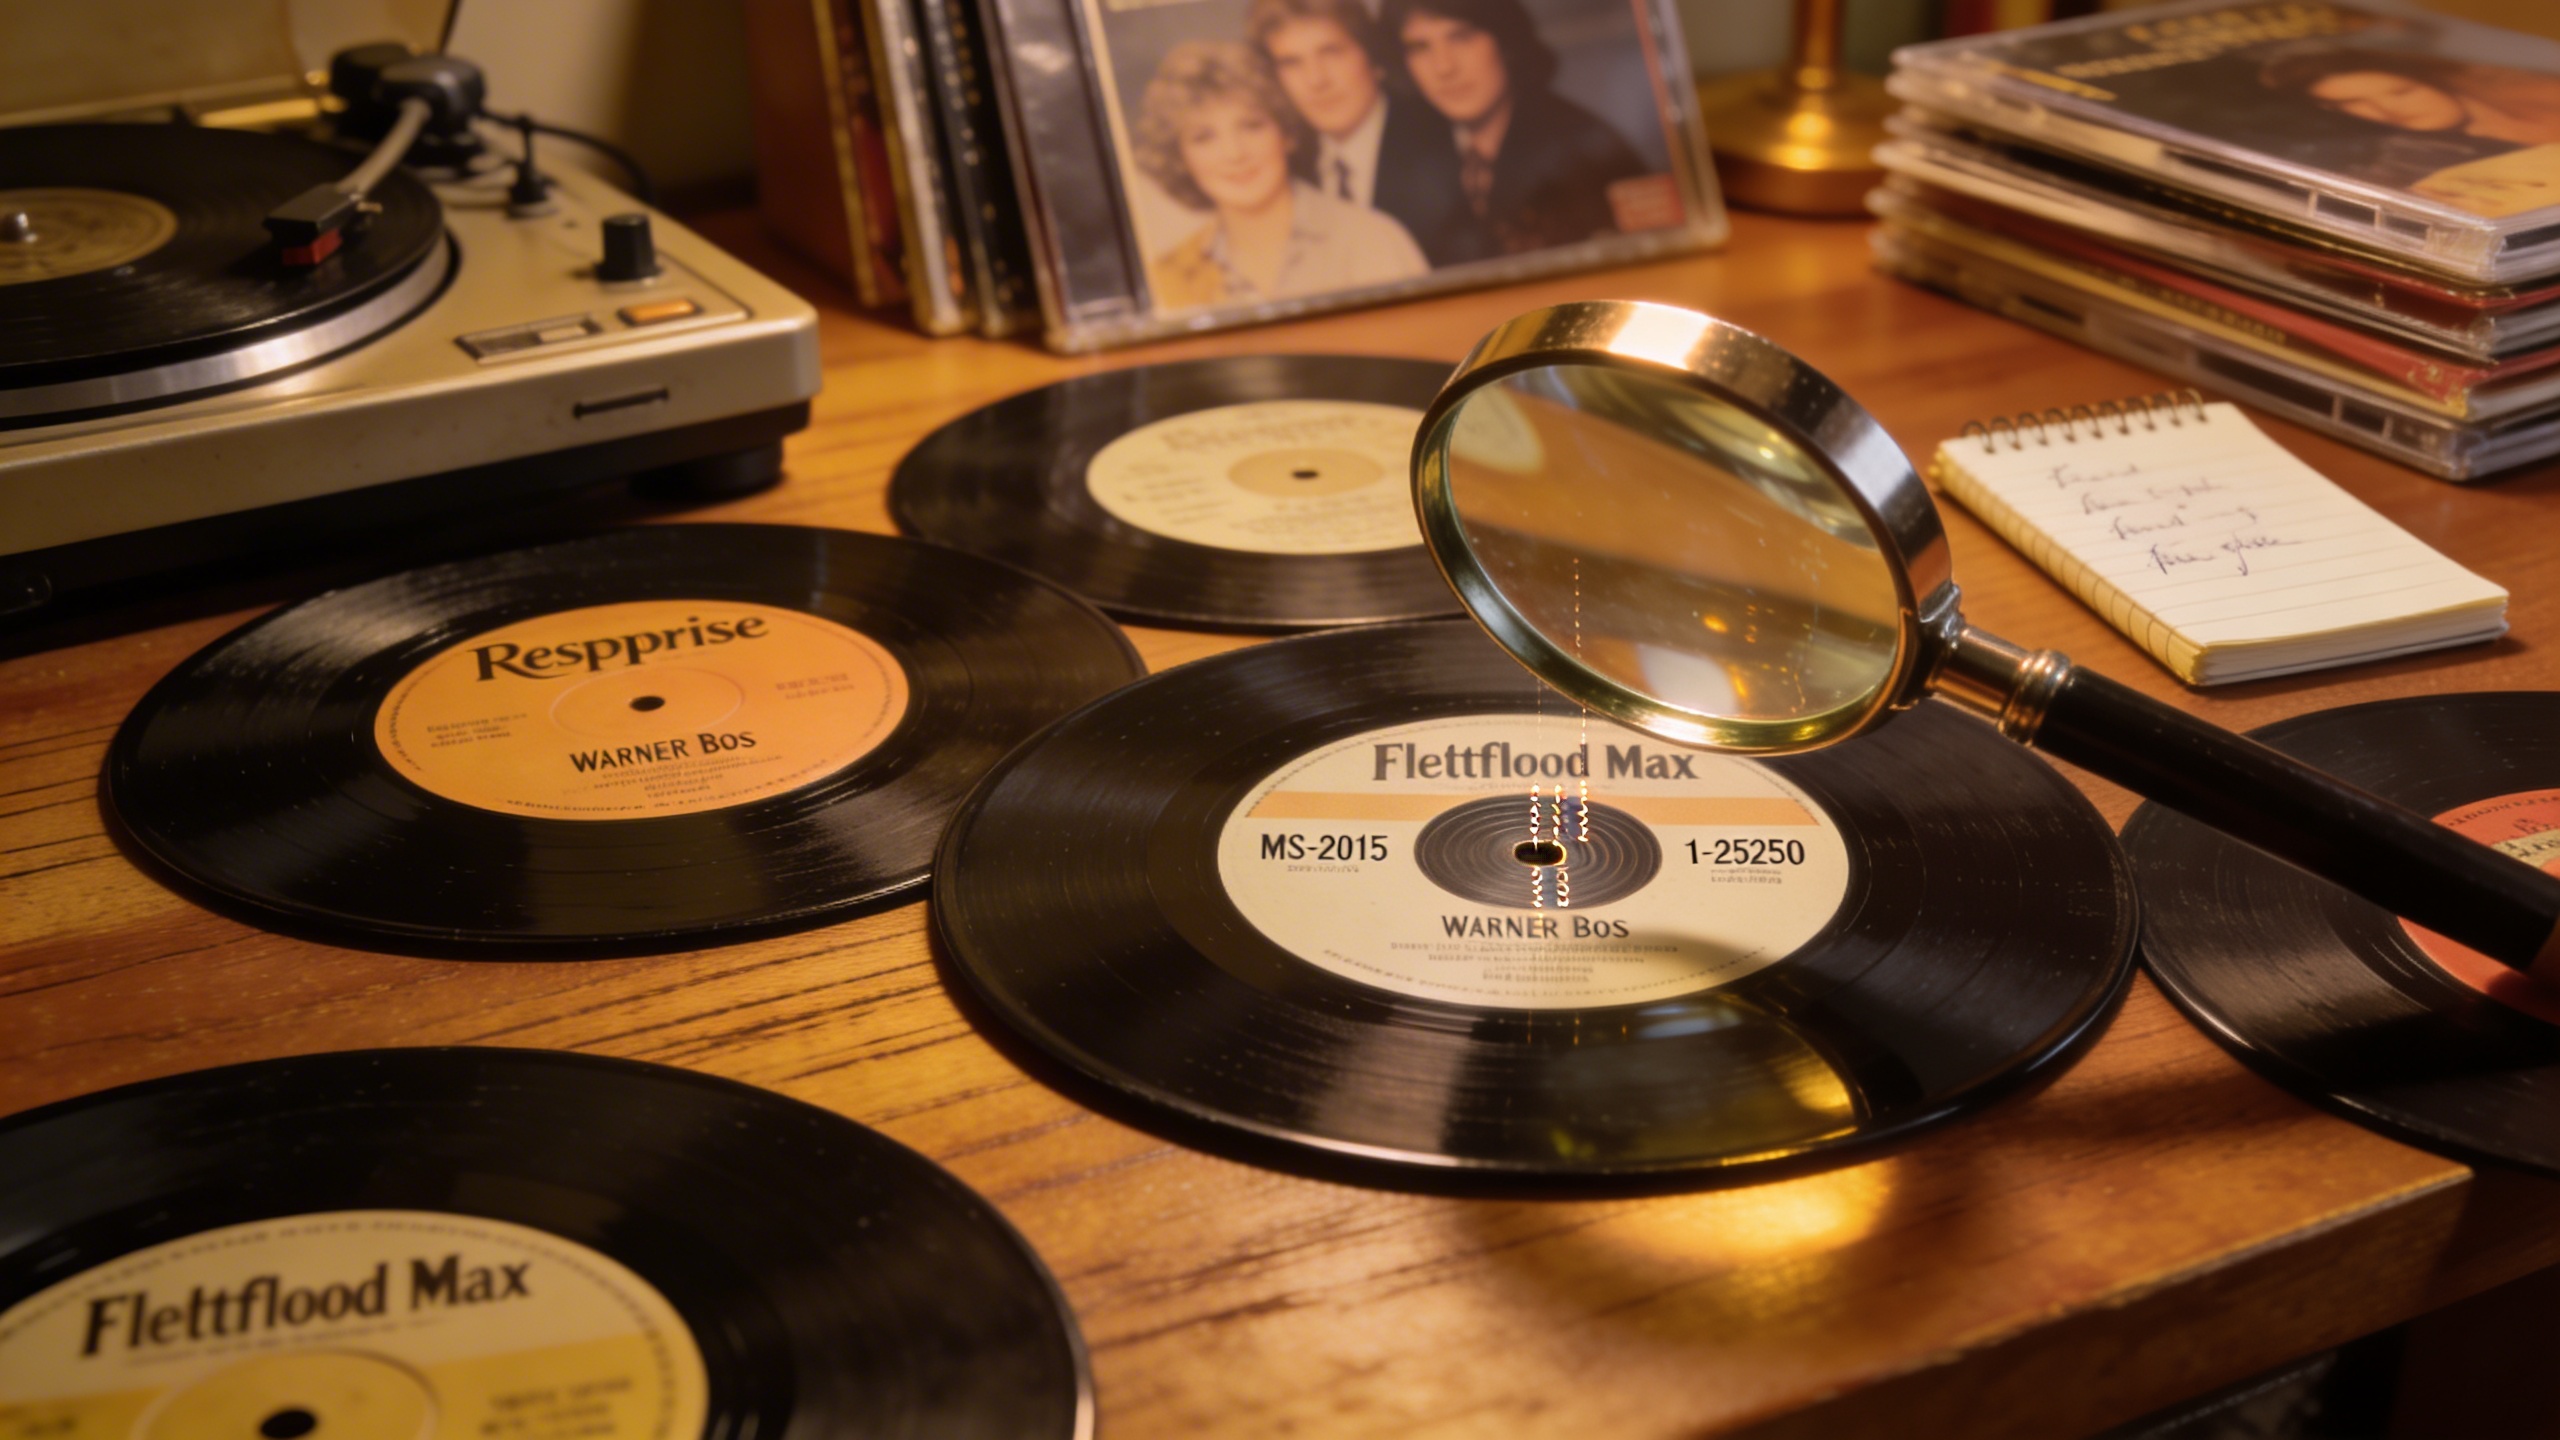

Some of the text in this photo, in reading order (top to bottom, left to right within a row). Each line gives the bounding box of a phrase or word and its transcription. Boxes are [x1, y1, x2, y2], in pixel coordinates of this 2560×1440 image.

[470, 614, 769, 681] Respprise
[570, 739, 690, 773] WARNER
[1373, 742, 1699, 782] Flettflood Max
[1261, 834, 1388, 861] MS-2015
[1685, 839, 1805, 865] 1-25250
[1441, 915, 1559, 938] WARNER
[82, 1262, 389, 1357] Flettflood
[410, 1254, 531, 1310] Max
